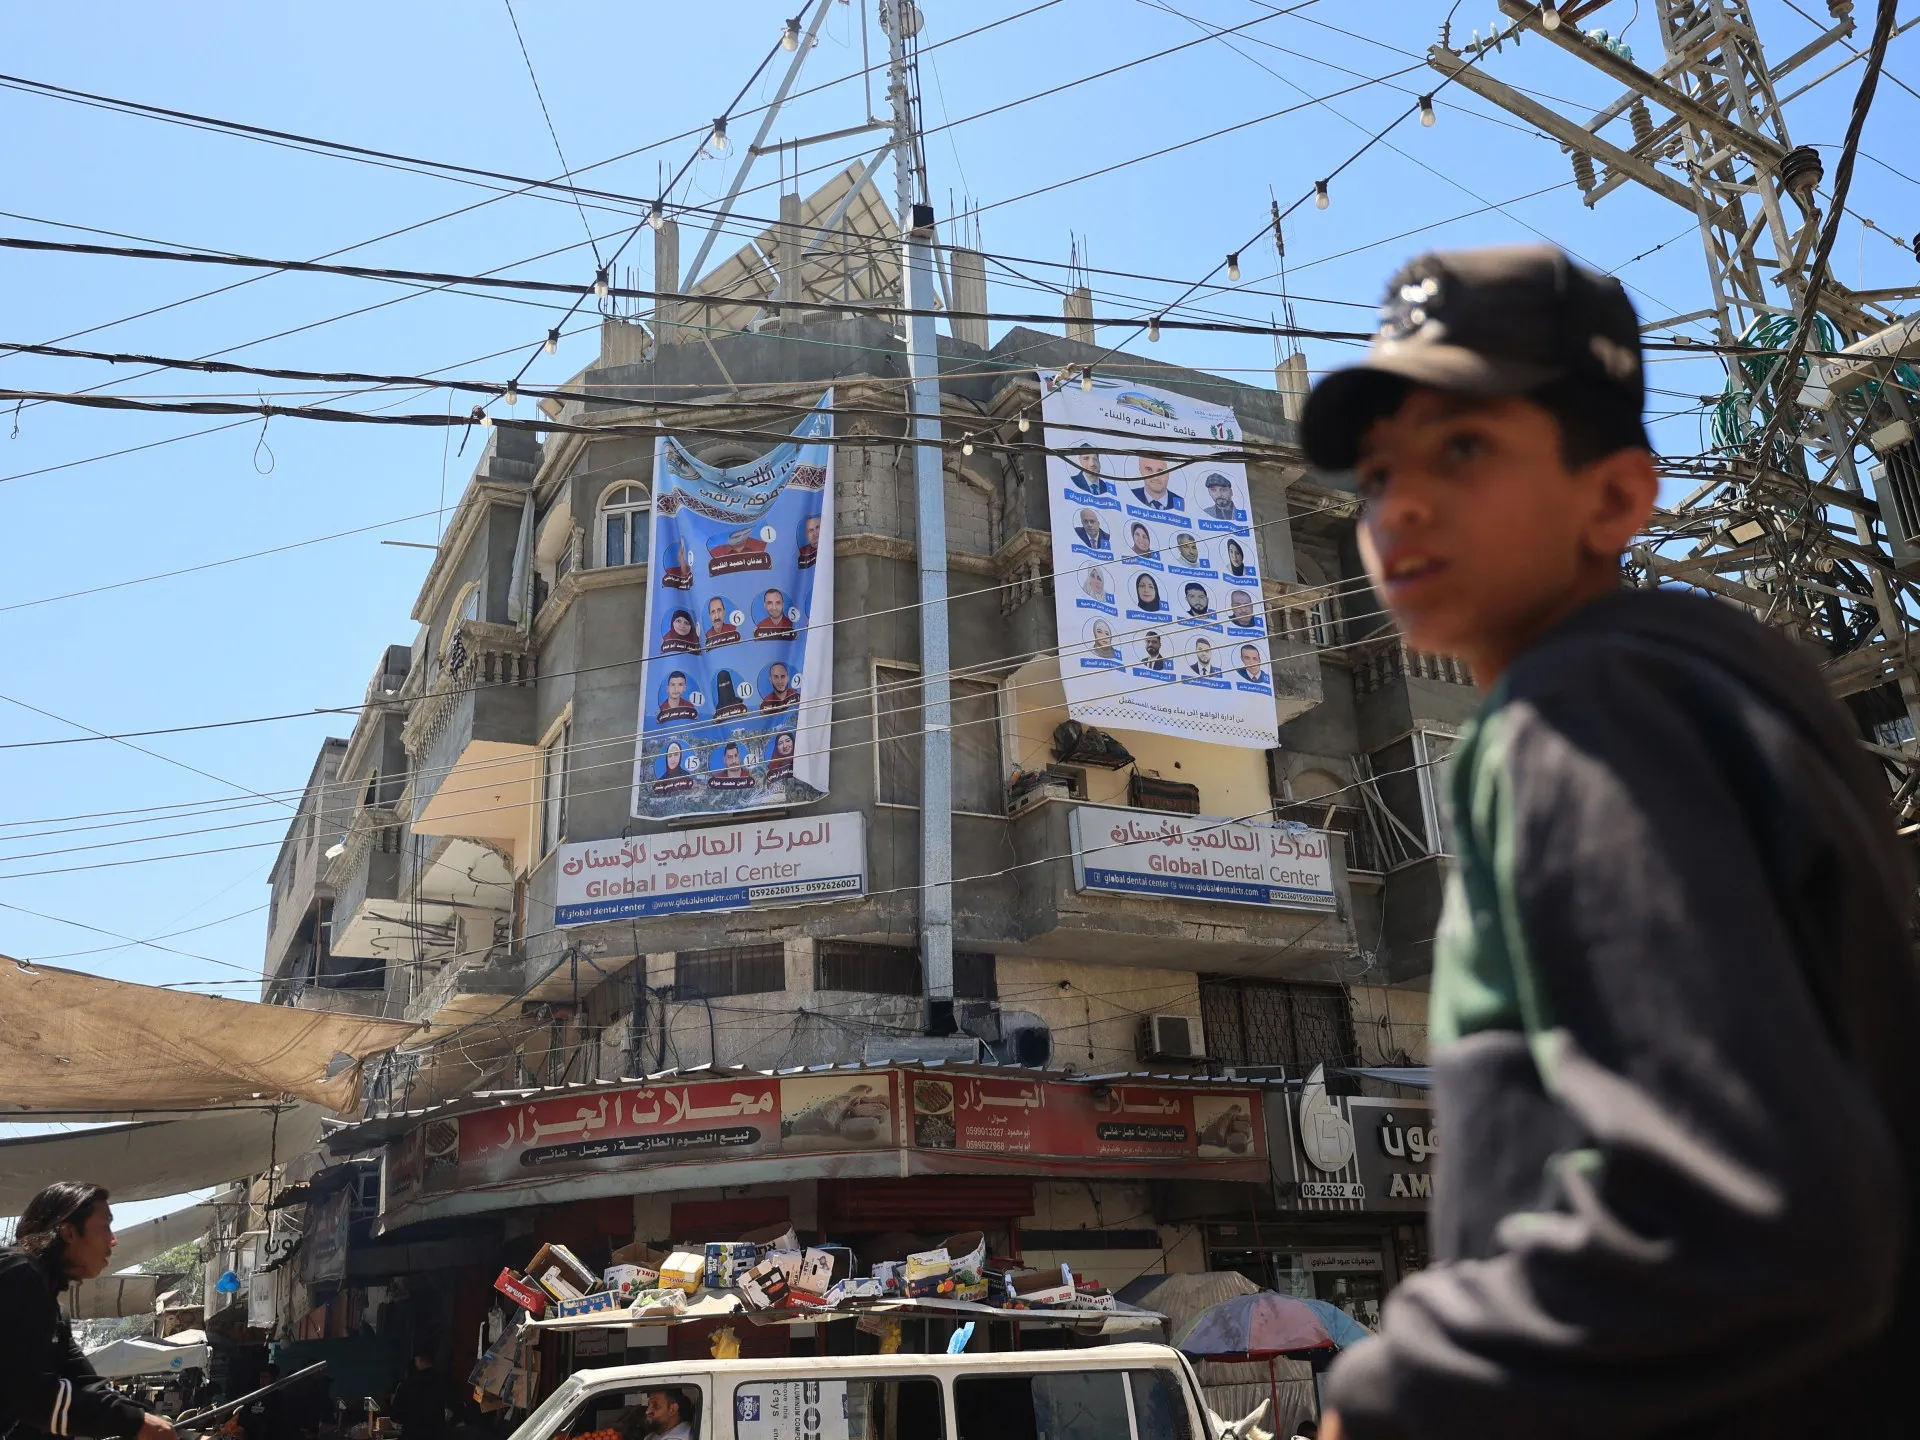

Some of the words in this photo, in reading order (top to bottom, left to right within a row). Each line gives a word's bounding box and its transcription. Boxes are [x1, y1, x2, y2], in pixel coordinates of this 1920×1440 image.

[1173, 425, 1196, 437] قائمة
[1173, 706, 1186, 716] بناء
[754, 821, 831, 856] المركز
[1110, 819, 1184, 848] للأسنان
[1187, 829, 1261, 852] العالمي
[562, 840, 647, 876] للأسنان
[653, 831, 742, 867] العالمي
[1270, 833, 1330, 861] المركز
[585, 874, 656, 898] Global
[666, 867, 728, 891] Dental
[735, 861, 802, 883] Center
[1104, 873, 1126, 884] global
[1126, 876, 1148, 887] dental
[1148, 878, 1169, 888] center
[1148, 854, 1208, 876] Global
[1212, 859, 1265, 882] Dental
[1269, 866, 1320, 887] Center
[750, 885, 800, 898] 0592626015
[806, 879, 857, 892] 0592626002
[567, 906, 592, 920] global
[593, 903, 619, 915] dental
[620, 902, 647, 913] center
[632, 1086, 775, 1128] محلات
[958, 1079, 1046, 1116] الجزار
[499, 1094, 622, 1149] الجزار
[619, 1137, 675, 1152] الطازجة
[676, 1134, 717, 1149] اللحوم
[719, 1130, 751, 1144] لبيع
[534, 1147, 568, 1166] ضاني
[578, 1143, 609, 1159] عجل
[1351, 1185, 1364, 1198] 40
[1389, 1172, 1437, 1198] AM
[743, 1396, 753, 1420] ISO
[770, 1389, 780, 1417] days
